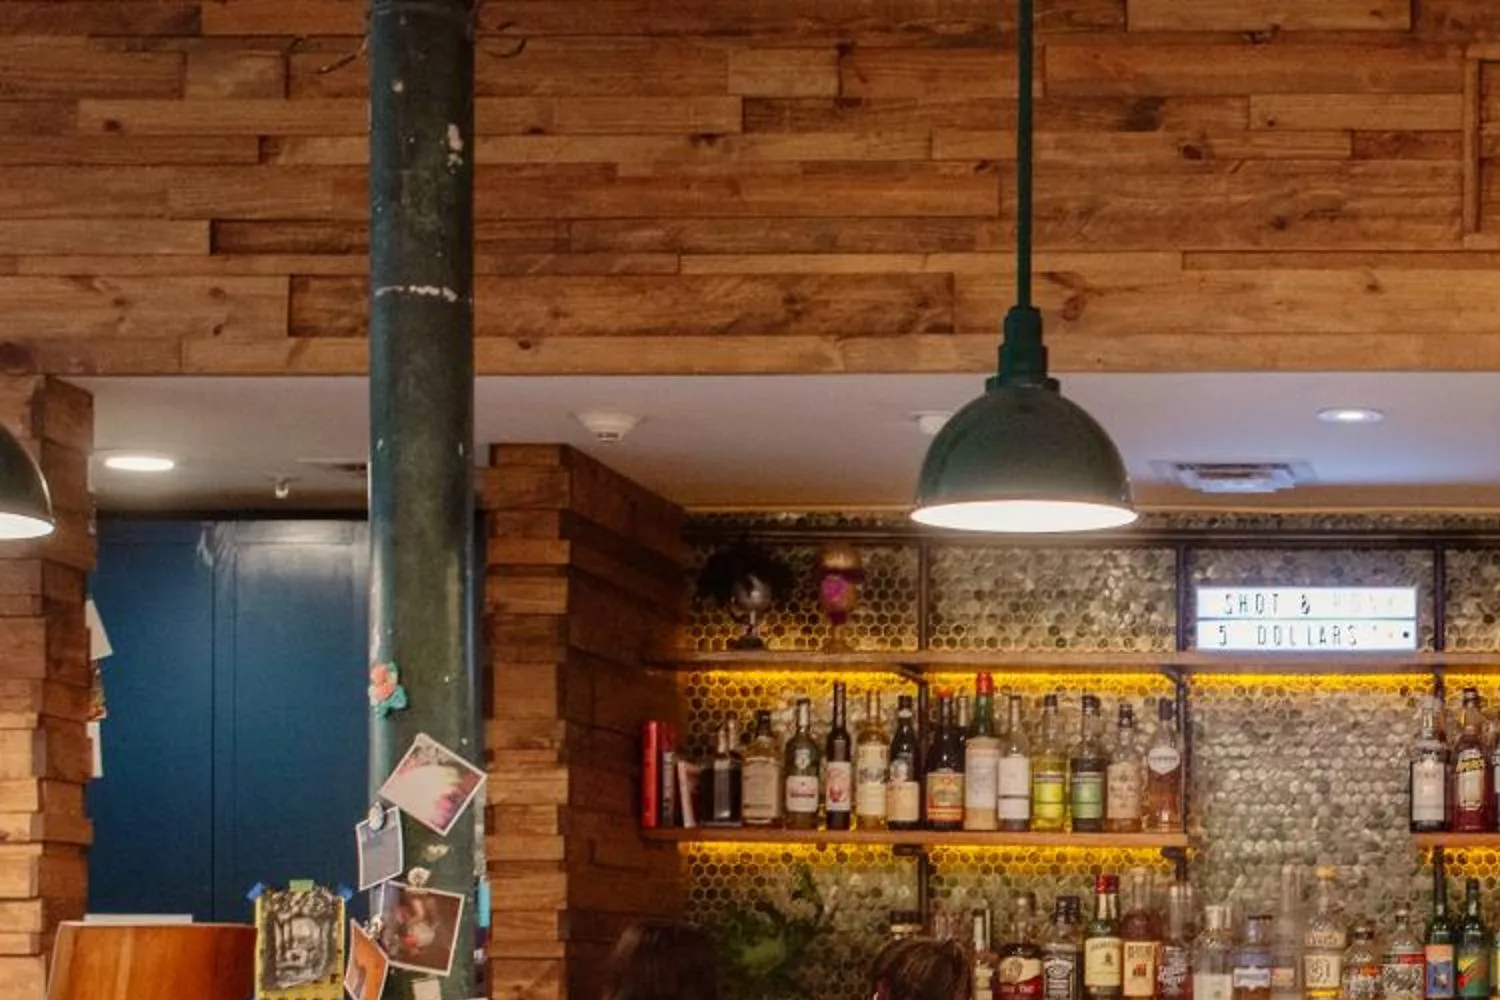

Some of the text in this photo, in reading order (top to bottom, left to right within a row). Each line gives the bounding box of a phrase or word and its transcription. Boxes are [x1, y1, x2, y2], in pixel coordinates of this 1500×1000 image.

[1224, 593, 1279, 615] SHOT
[1300, 594, 1311, 615] &
[1217, 625, 1358, 647] 5 DOLLARS
